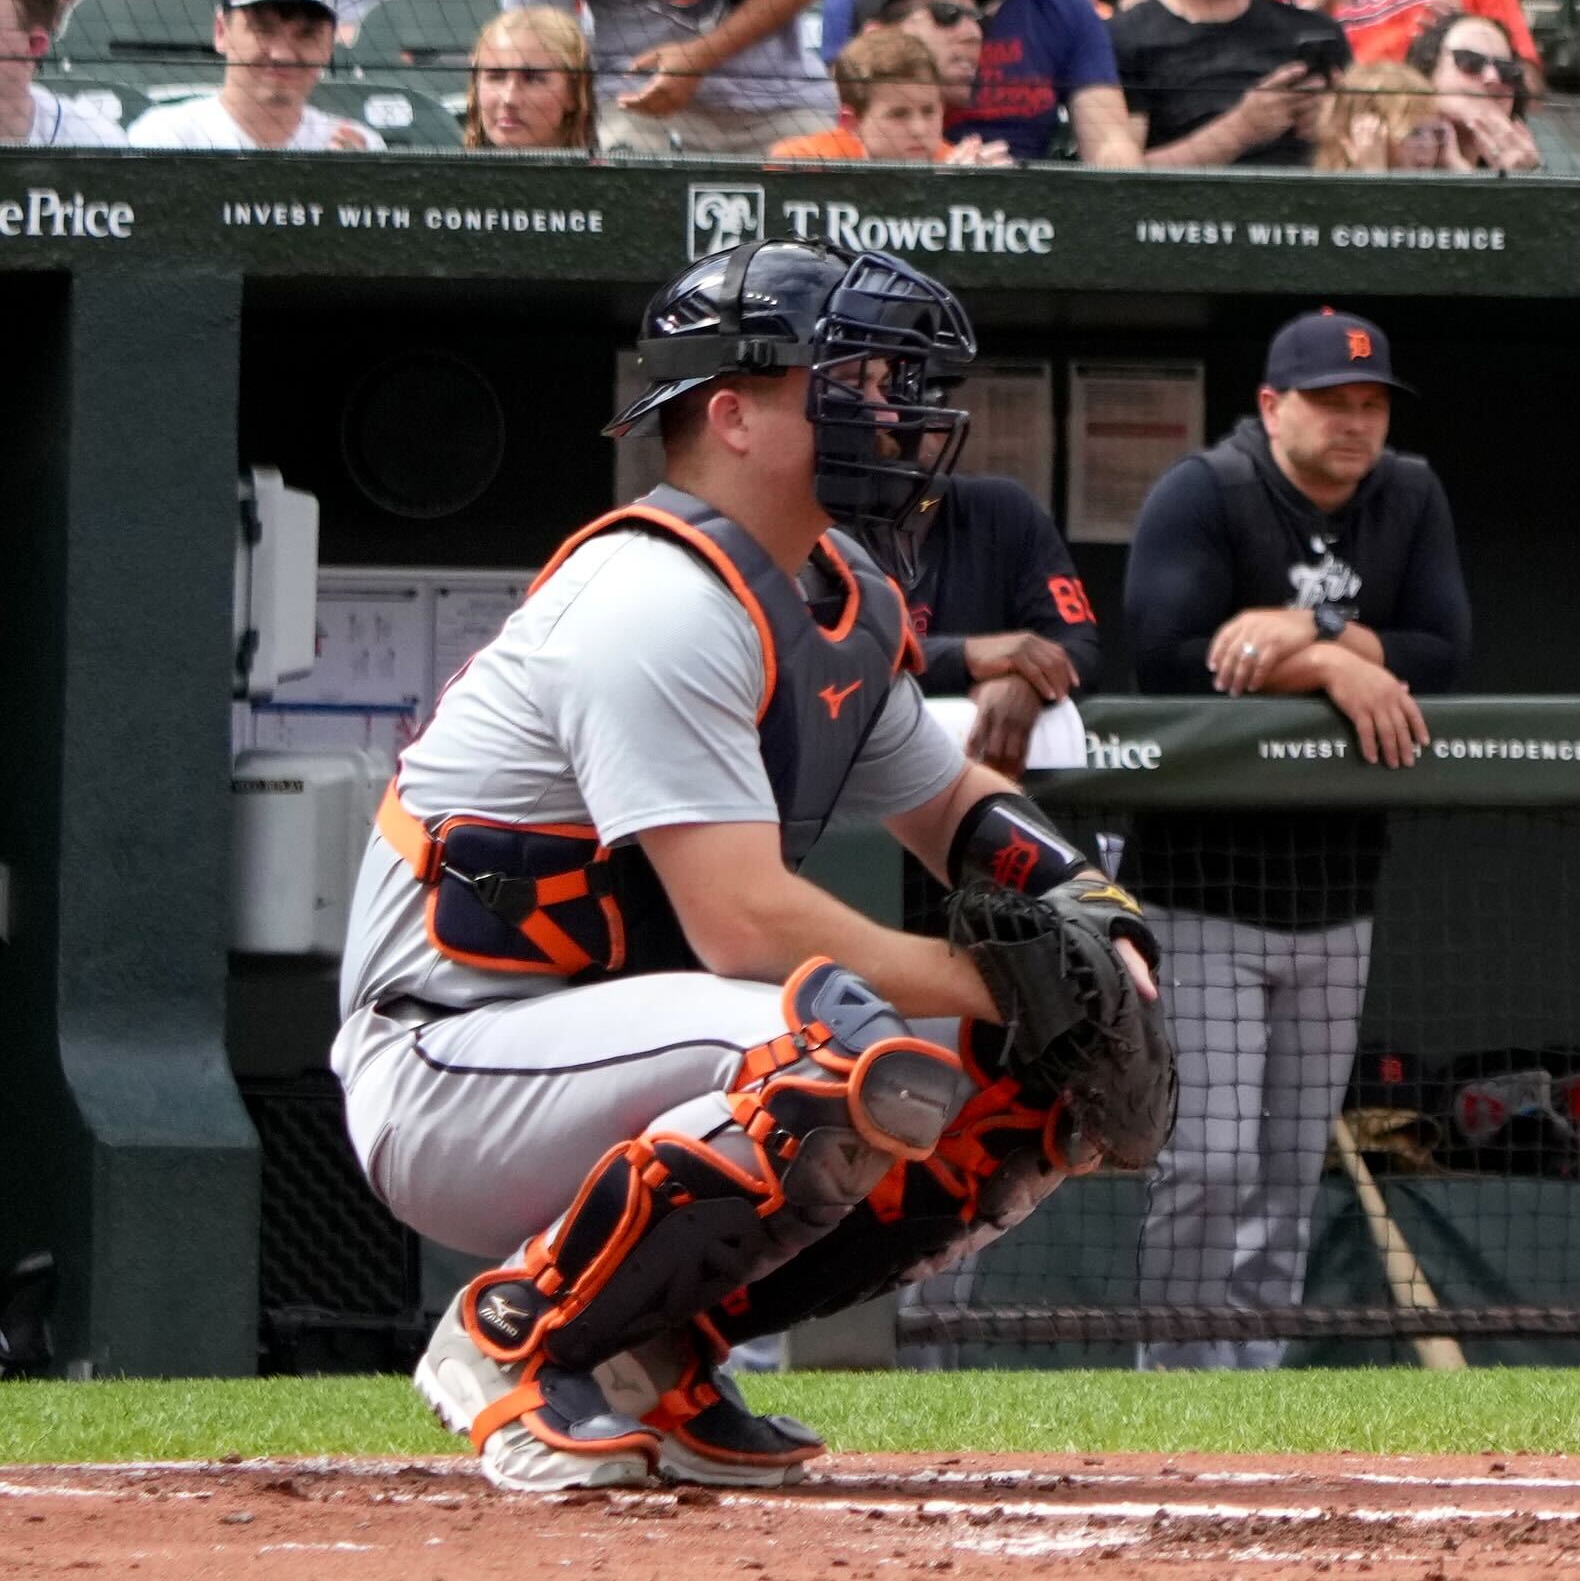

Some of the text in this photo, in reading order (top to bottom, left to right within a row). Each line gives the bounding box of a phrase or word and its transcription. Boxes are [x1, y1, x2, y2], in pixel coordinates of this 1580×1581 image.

[223, 203, 603, 233] INVEST WITH CONFIDENCE
[1136, 220, 1505, 251] INVEST WITH CONFIDENCE
[1259, 739, 1347, 759] INVEST
